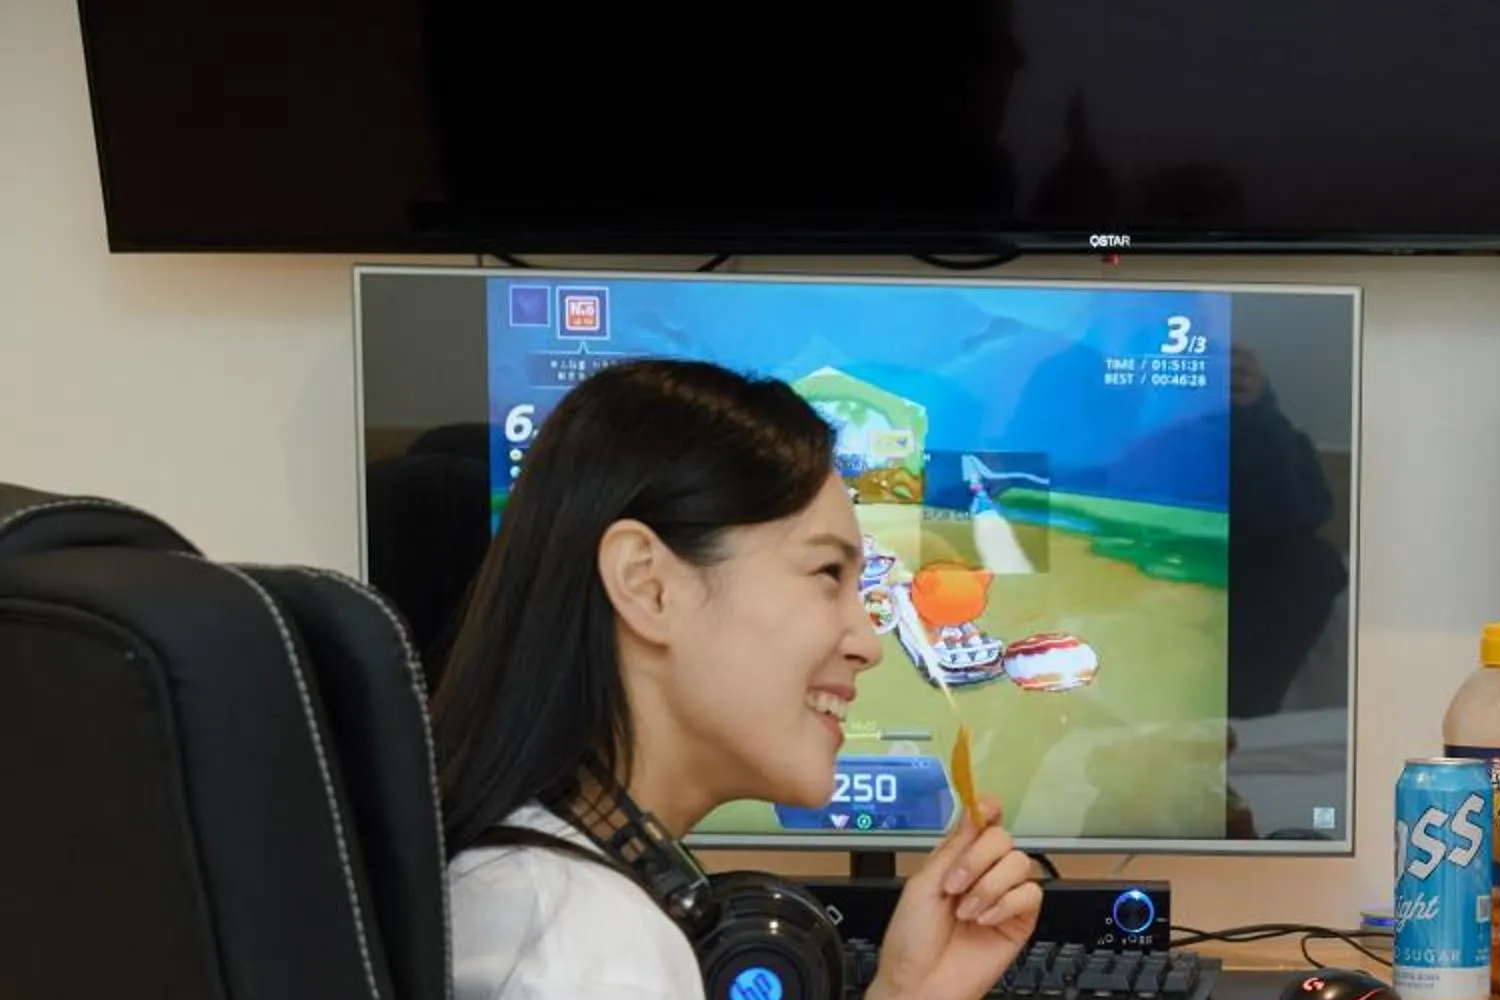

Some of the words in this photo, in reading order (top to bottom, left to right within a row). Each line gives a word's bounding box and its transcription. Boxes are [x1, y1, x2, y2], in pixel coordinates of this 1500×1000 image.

[505, 404, 535, 442] 6
[831, 773, 897, 803] 250
[1396, 892, 1440, 932] ight
